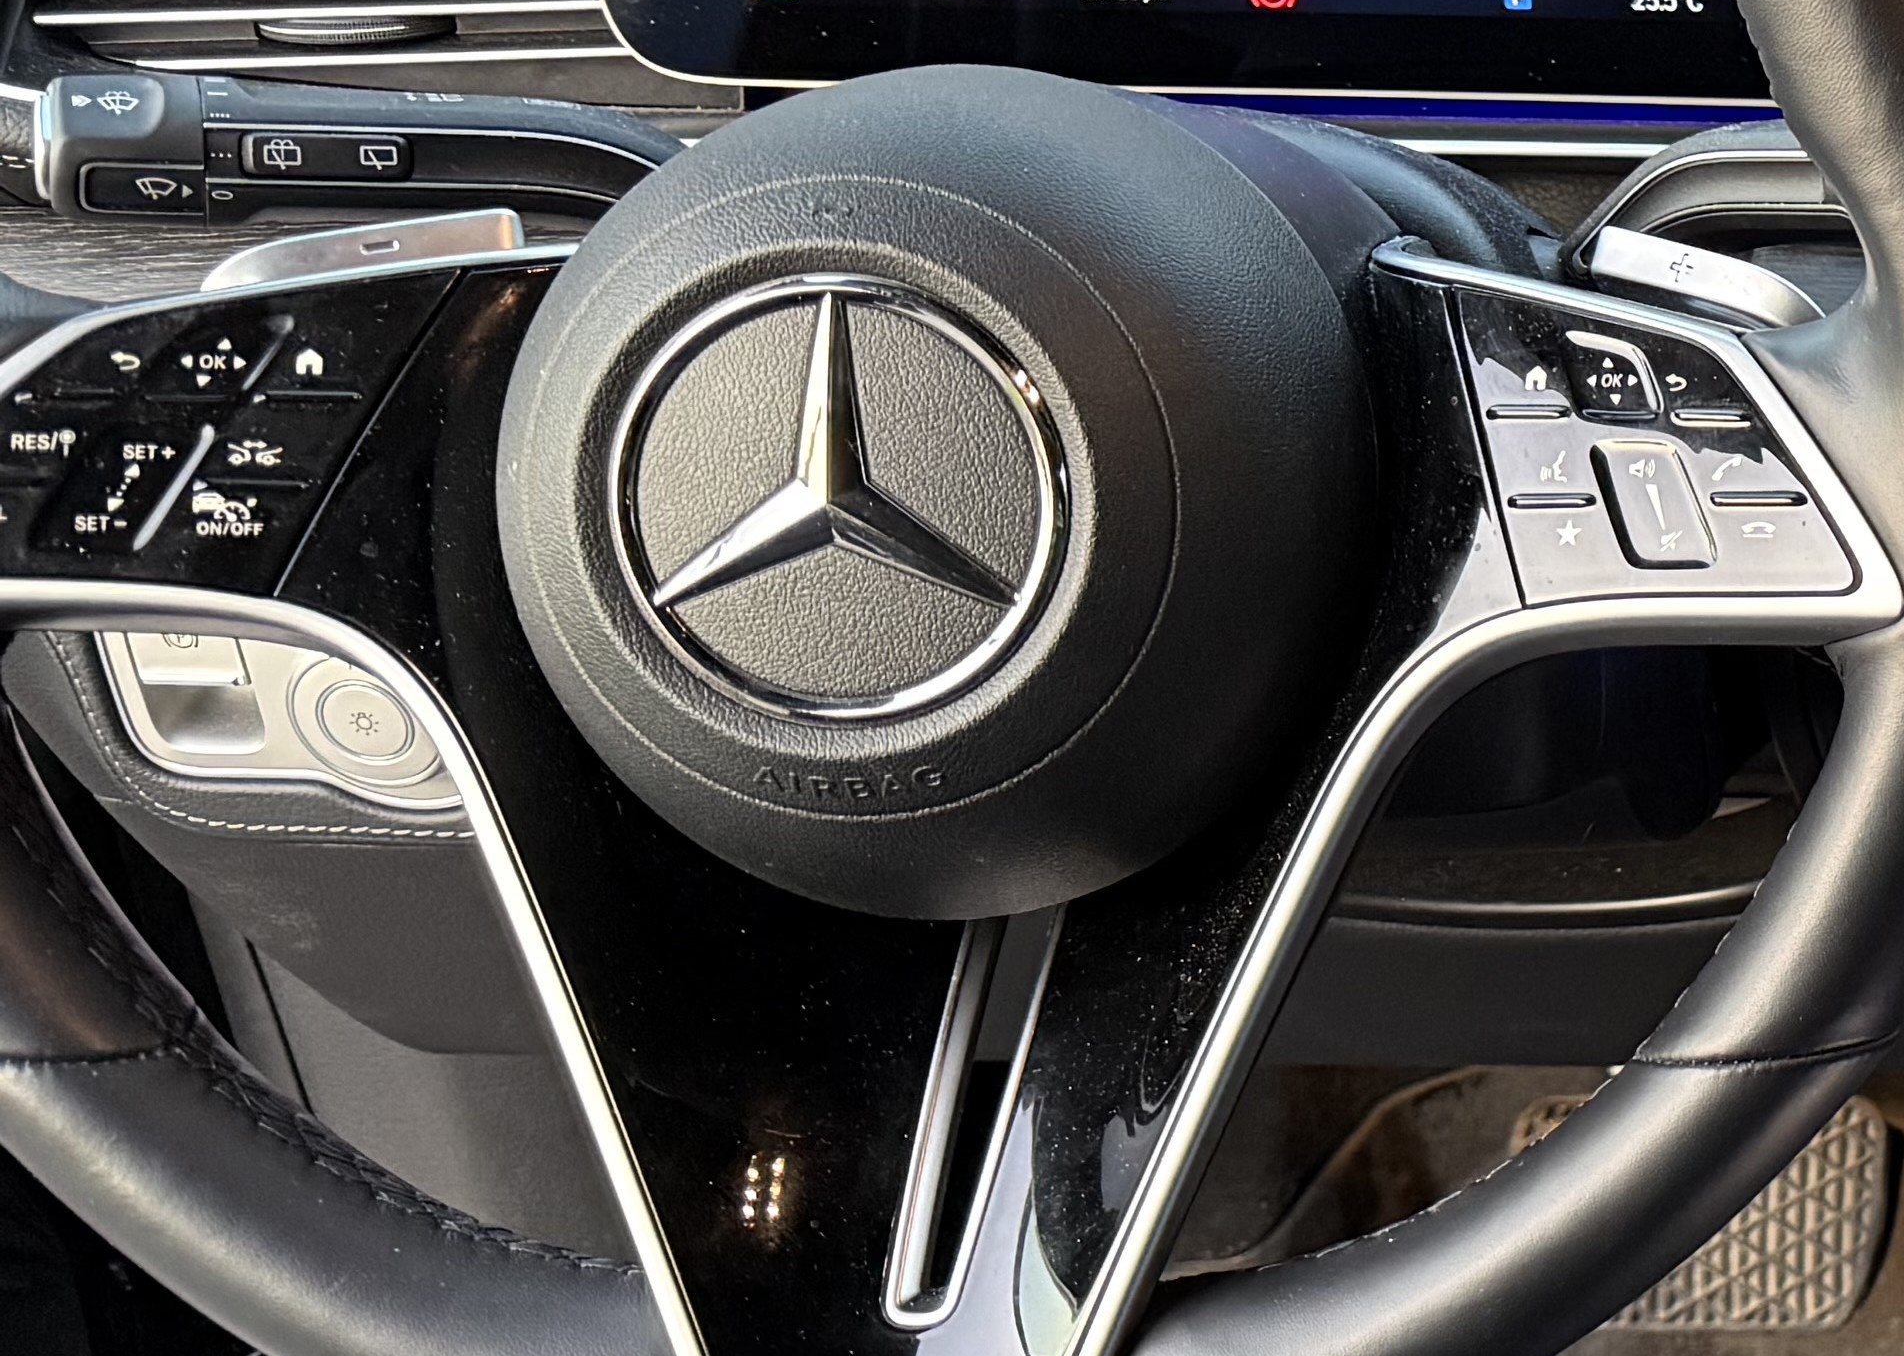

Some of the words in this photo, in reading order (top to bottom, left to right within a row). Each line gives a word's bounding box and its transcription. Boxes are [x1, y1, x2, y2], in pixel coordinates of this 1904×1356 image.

[199, 354, 227, 370] OK
[1600, 373, 1624, 388] OK
[10, 430, 61, 451] RES/
[122, 443, 159, 461] SET
[74, 515, 111, 532] SET
[196, 522, 264, 536] ON/OFF
[753, 765, 946, 798] AIRBAG
